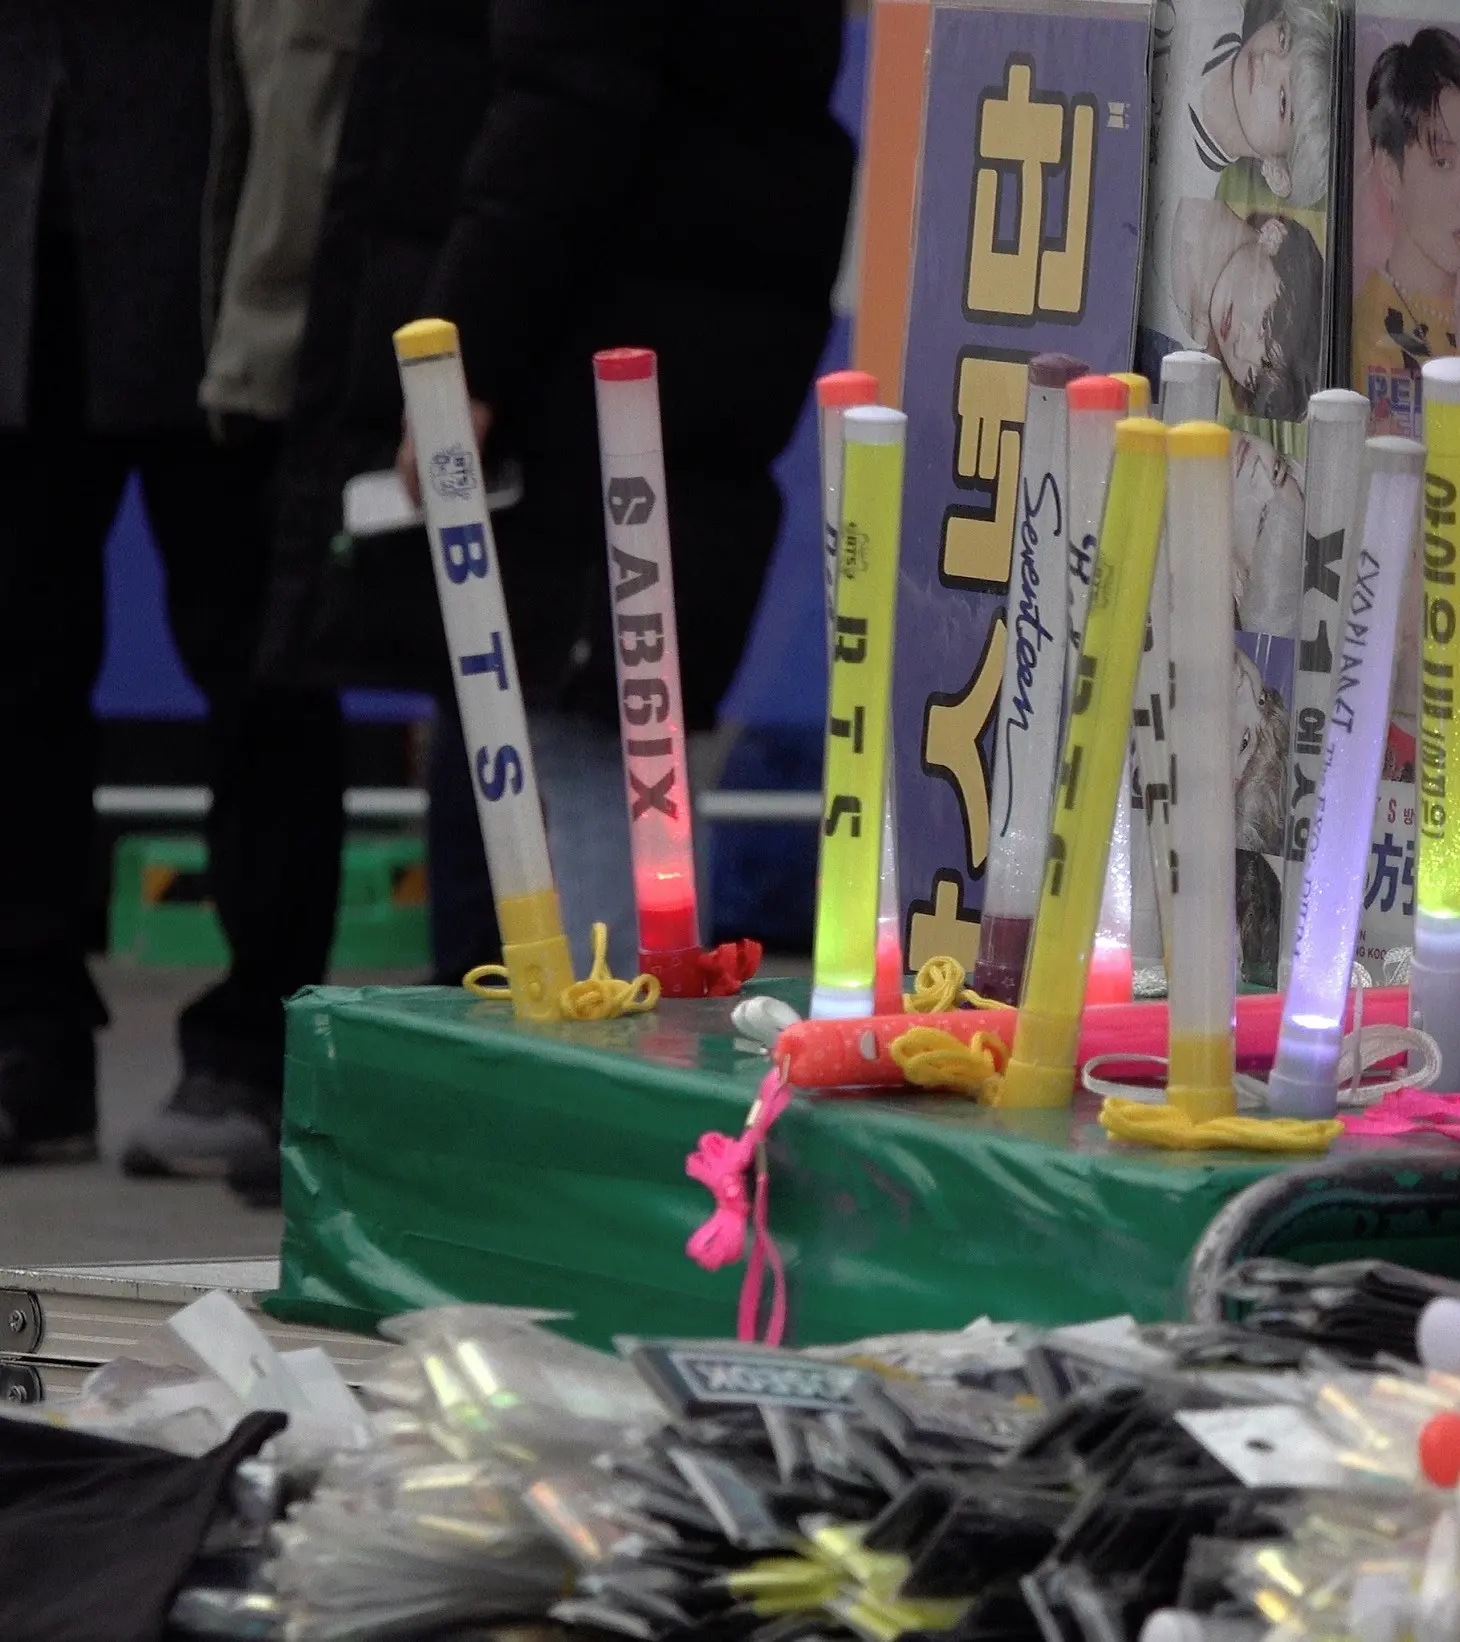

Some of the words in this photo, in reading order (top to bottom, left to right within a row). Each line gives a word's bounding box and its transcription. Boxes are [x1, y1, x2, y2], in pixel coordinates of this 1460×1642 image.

[438, 521, 525, 803] BTS
[609, 545, 679, 822] AB6IX
[822, 615, 869, 839] BTS
[1001, 472, 1063, 838] Seventeen
